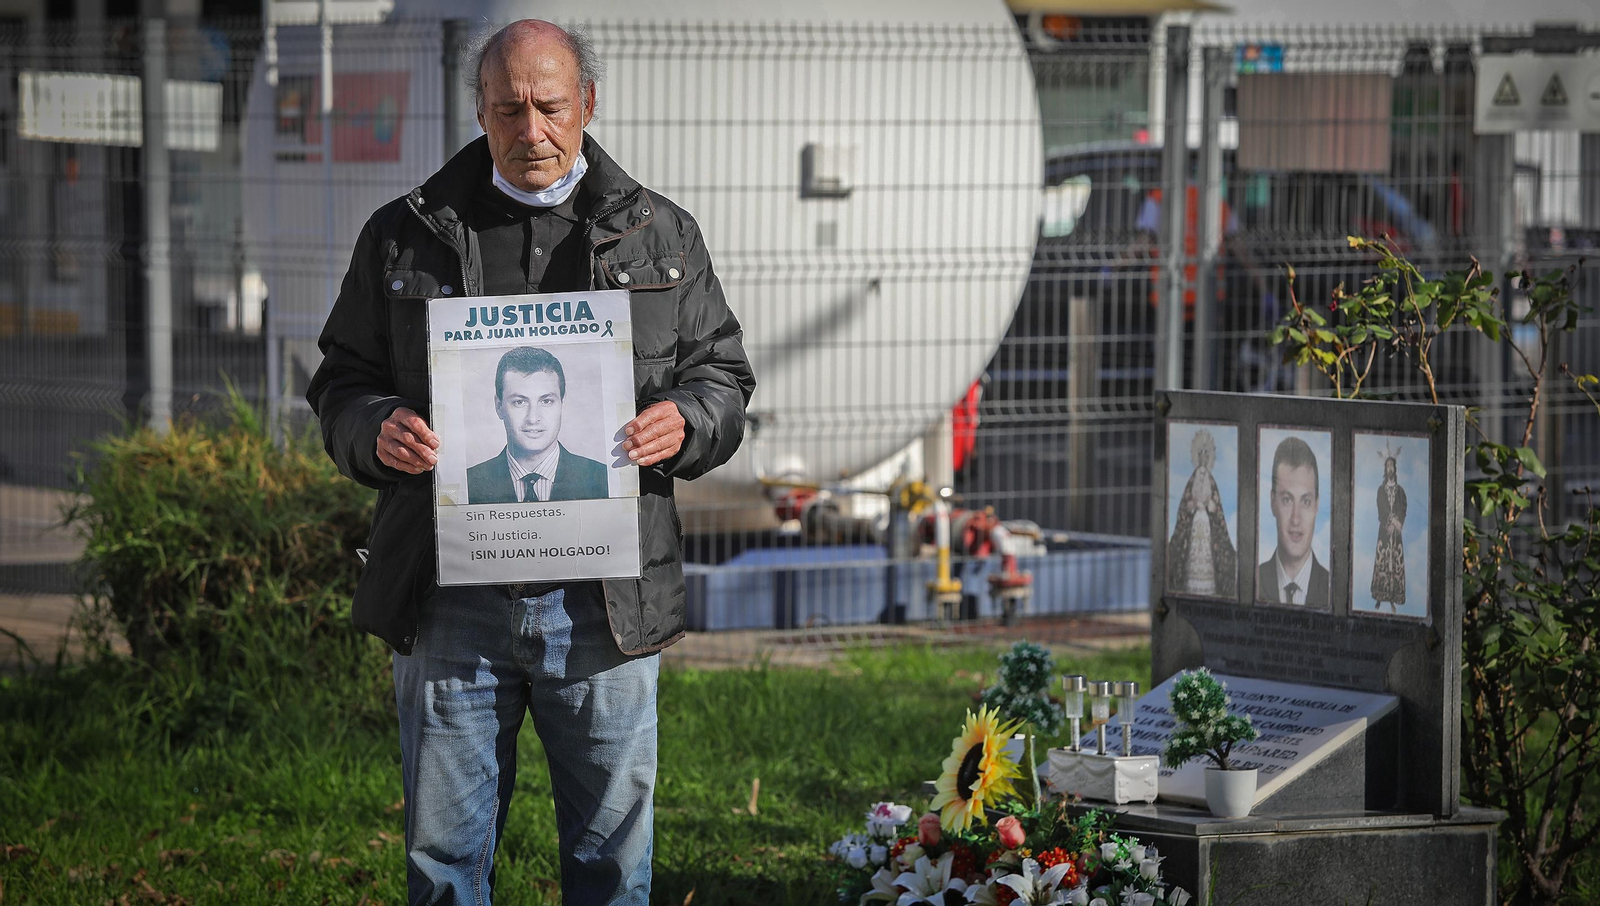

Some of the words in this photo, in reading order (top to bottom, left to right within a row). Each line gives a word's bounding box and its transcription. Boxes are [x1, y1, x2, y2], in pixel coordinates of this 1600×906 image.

[464, 300, 595, 328] JUSTICIA
[444, 329, 484, 342] PARA
[486, 327, 525, 340] JUAN
[528, 322, 600, 336] HOLGADO
[466, 511, 485, 521] Sin
[489, 508, 566, 521] Respuestas.
[468, 531, 488, 541] Sin
[491, 529, 542, 541] Justicia.
[470, 549, 497, 561] ¡SIN
[500, 548, 536, 559] JUAN
[539, 545, 611, 558] HOLGADO!
[1288, 698, 1338, 711] MEMORIA
[1238, 704, 1303, 721] HOLGADO,
[1259, 721, 1325, 736] CAMPSARED
